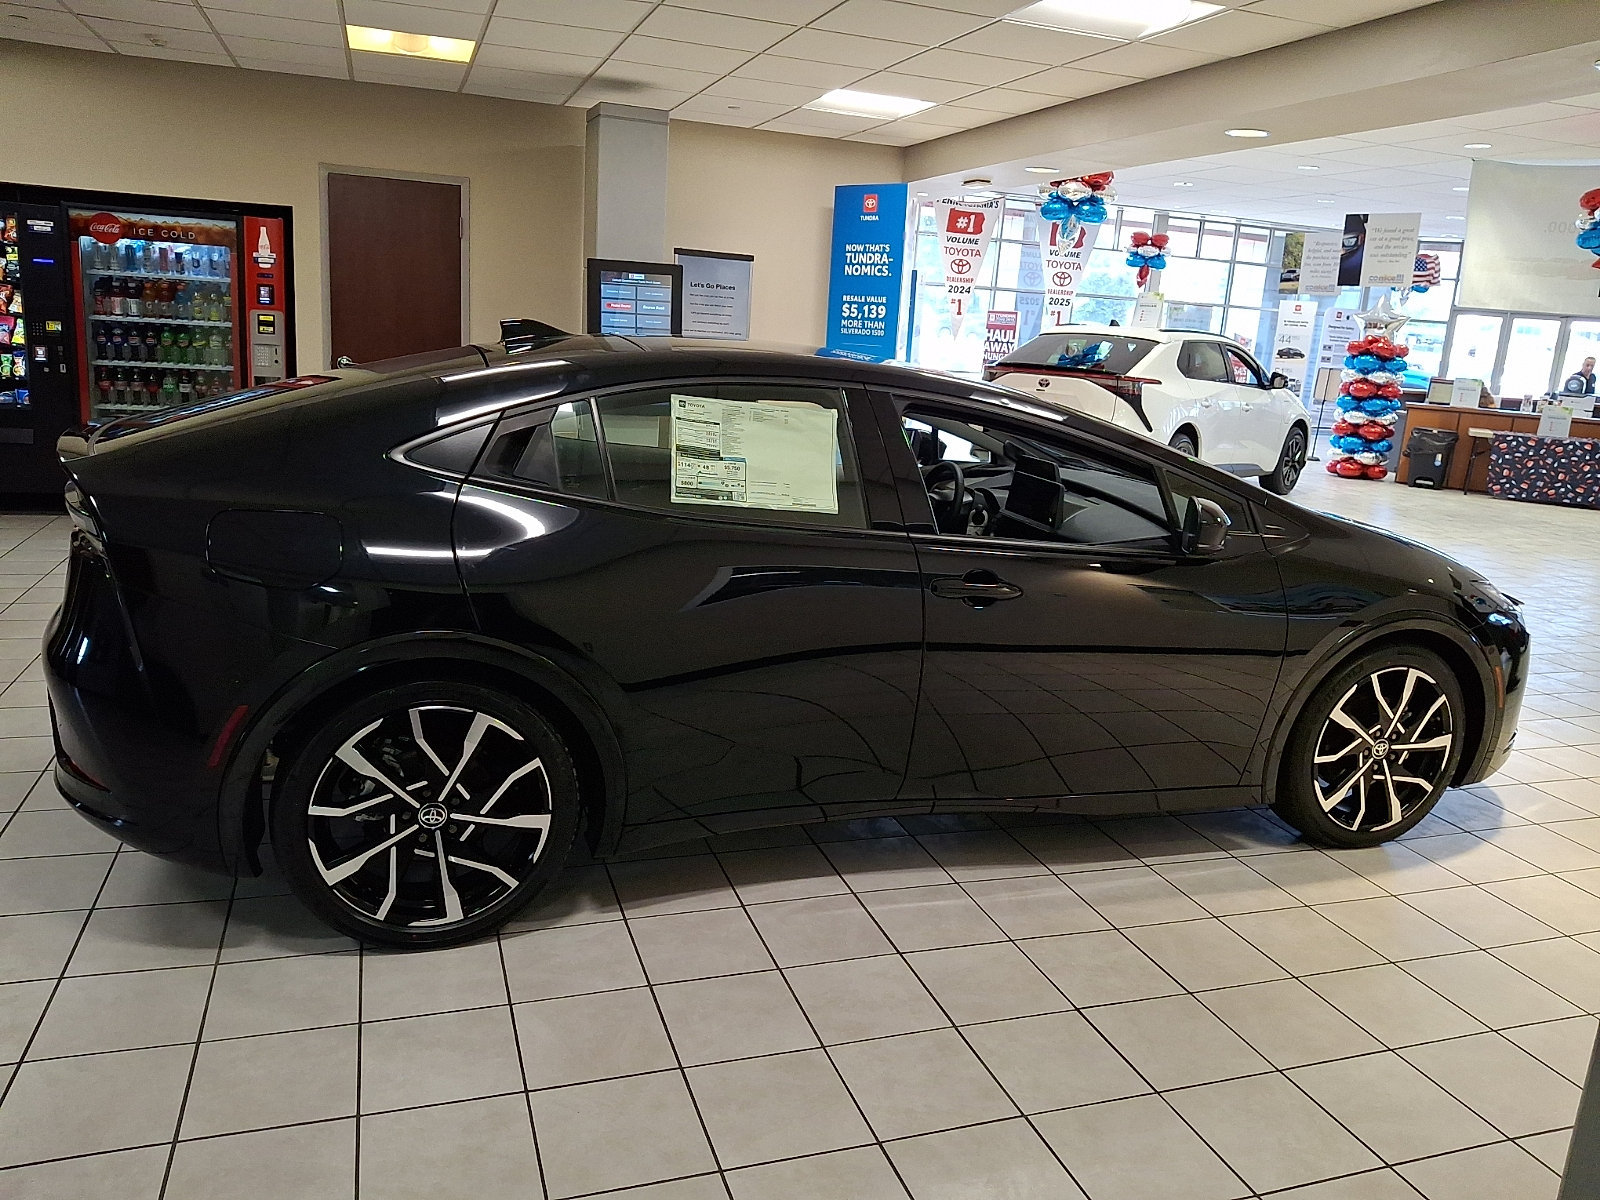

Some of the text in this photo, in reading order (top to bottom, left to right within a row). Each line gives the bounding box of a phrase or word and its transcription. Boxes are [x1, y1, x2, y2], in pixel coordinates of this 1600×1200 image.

[90, 222, 121, 234] Coca-Cola
[956, 214, 976, 233] #1
[133, 228, 195, 239] ICE COLD
[946, 236, 980, 245] VOLUME
[845, 244, 890, 252] NOW THAT'S
[944, 246, 982, 258] TOYOTA
[845, 253, 894, 264] TUNDRA-
[1049, 249, 1082, 259] VOUME
[844, 265, 892, 277] NOMICS.
[1046, 260, 1082, 271] TOYOTA
[946, 276, 974, 284] DEALERSHIP
[948, 285, 972, 294] 2024
[1047, 288, 1074, 296] DEALERSHIP
[950, 298, 963, 316] #1
[1048, 297, 1071, 307] 2025
[841, 303, 887, 319] $5,139
[1050, 310, 1062, 326] #1
[841, 319, 885, 329] MORE THAN
[986, 329, 1015, 342] HAUL
[984, 341, 1015, 354] AWAY
